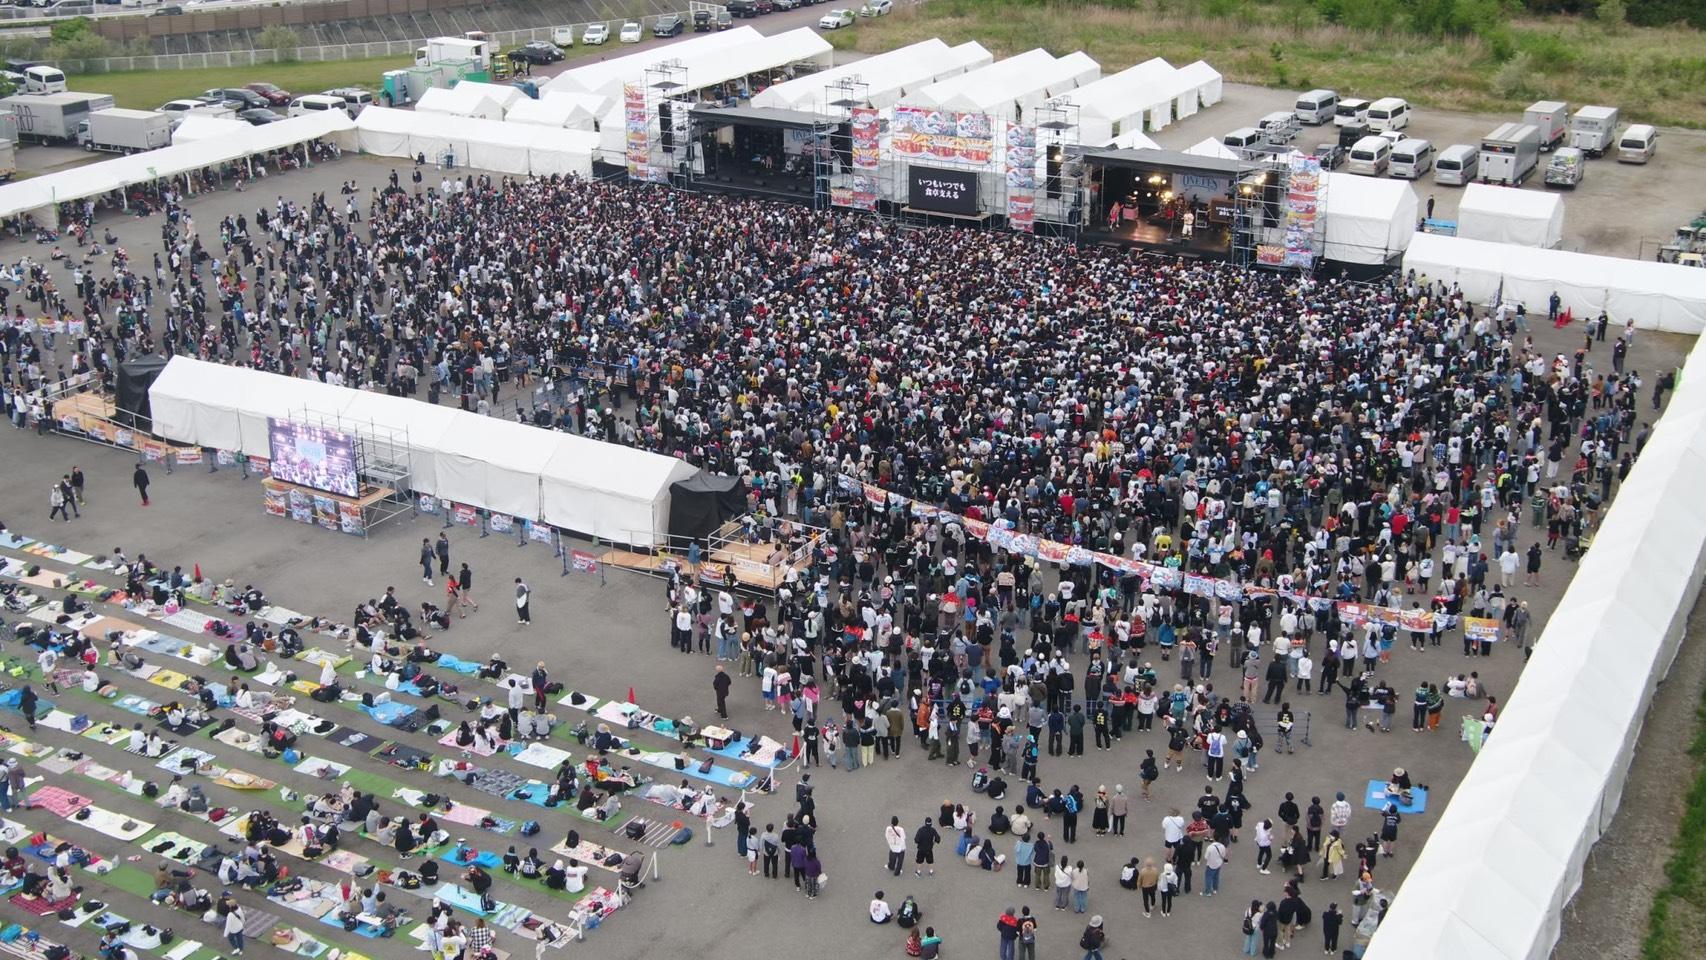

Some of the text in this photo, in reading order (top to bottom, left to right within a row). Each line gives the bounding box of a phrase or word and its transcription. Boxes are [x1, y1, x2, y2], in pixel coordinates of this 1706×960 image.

[918, 179, 966, 191] いつもいつでも
